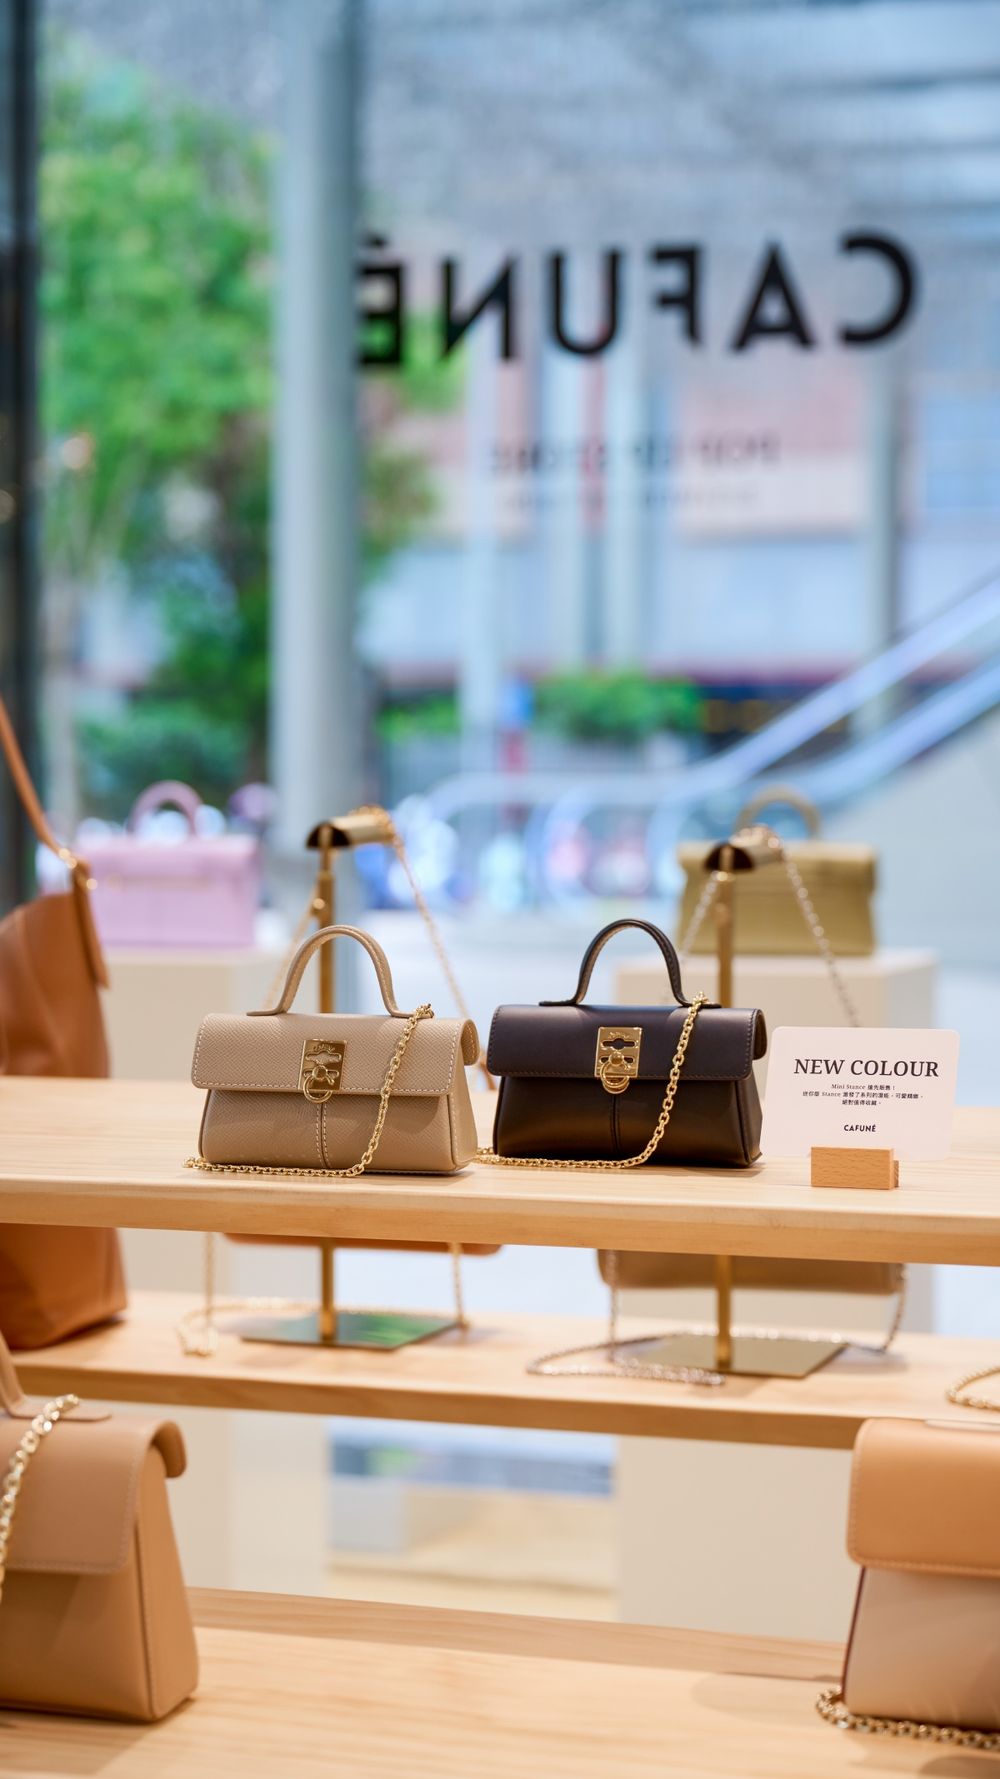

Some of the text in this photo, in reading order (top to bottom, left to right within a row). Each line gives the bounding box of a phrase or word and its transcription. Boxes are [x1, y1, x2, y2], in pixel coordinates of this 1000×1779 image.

[794, 1058, 939, 1077] NEW COLOUR
[843, 1124, 877, 1133] CAFUNÉ
